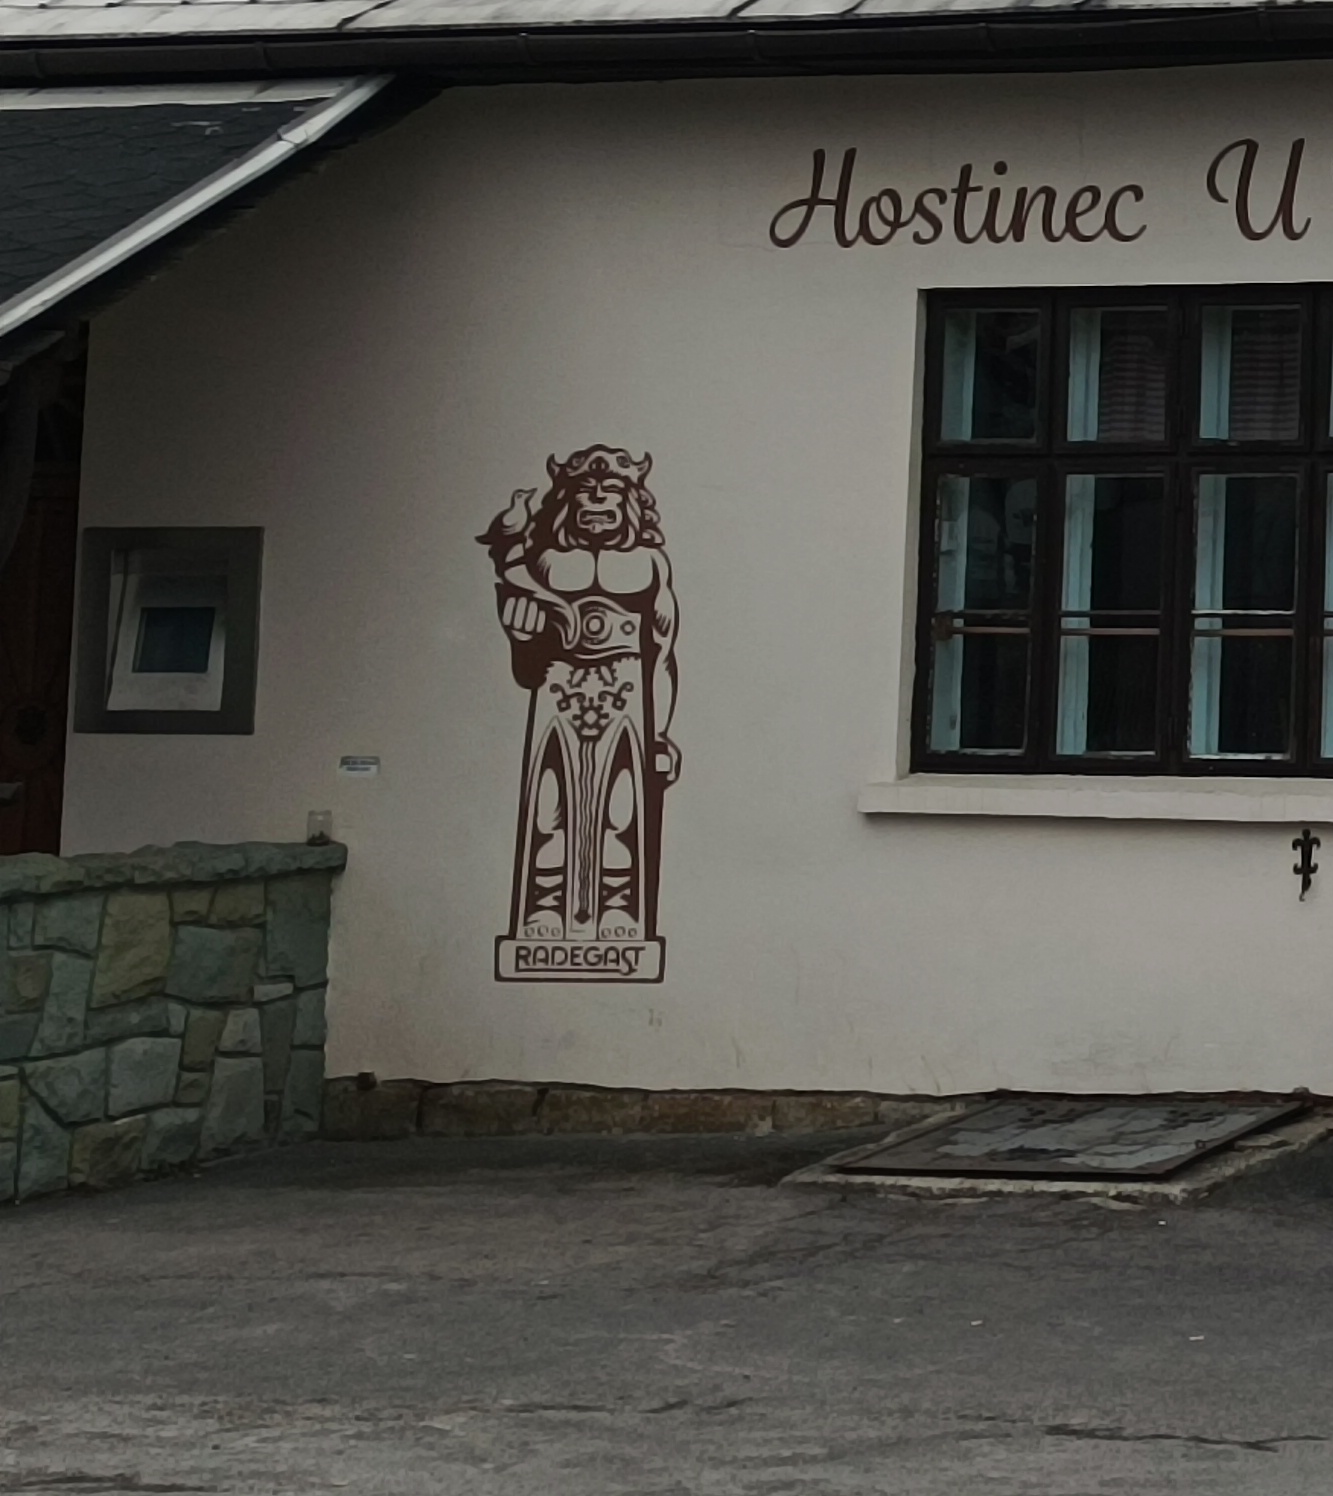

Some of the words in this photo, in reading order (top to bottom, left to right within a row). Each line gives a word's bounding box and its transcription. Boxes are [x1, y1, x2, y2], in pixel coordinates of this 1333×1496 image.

[769, 147, 1148, 248] Hostinec
[1206, 138, 1312, 241] U
[515, 946, 646, 976] RADEGAST
